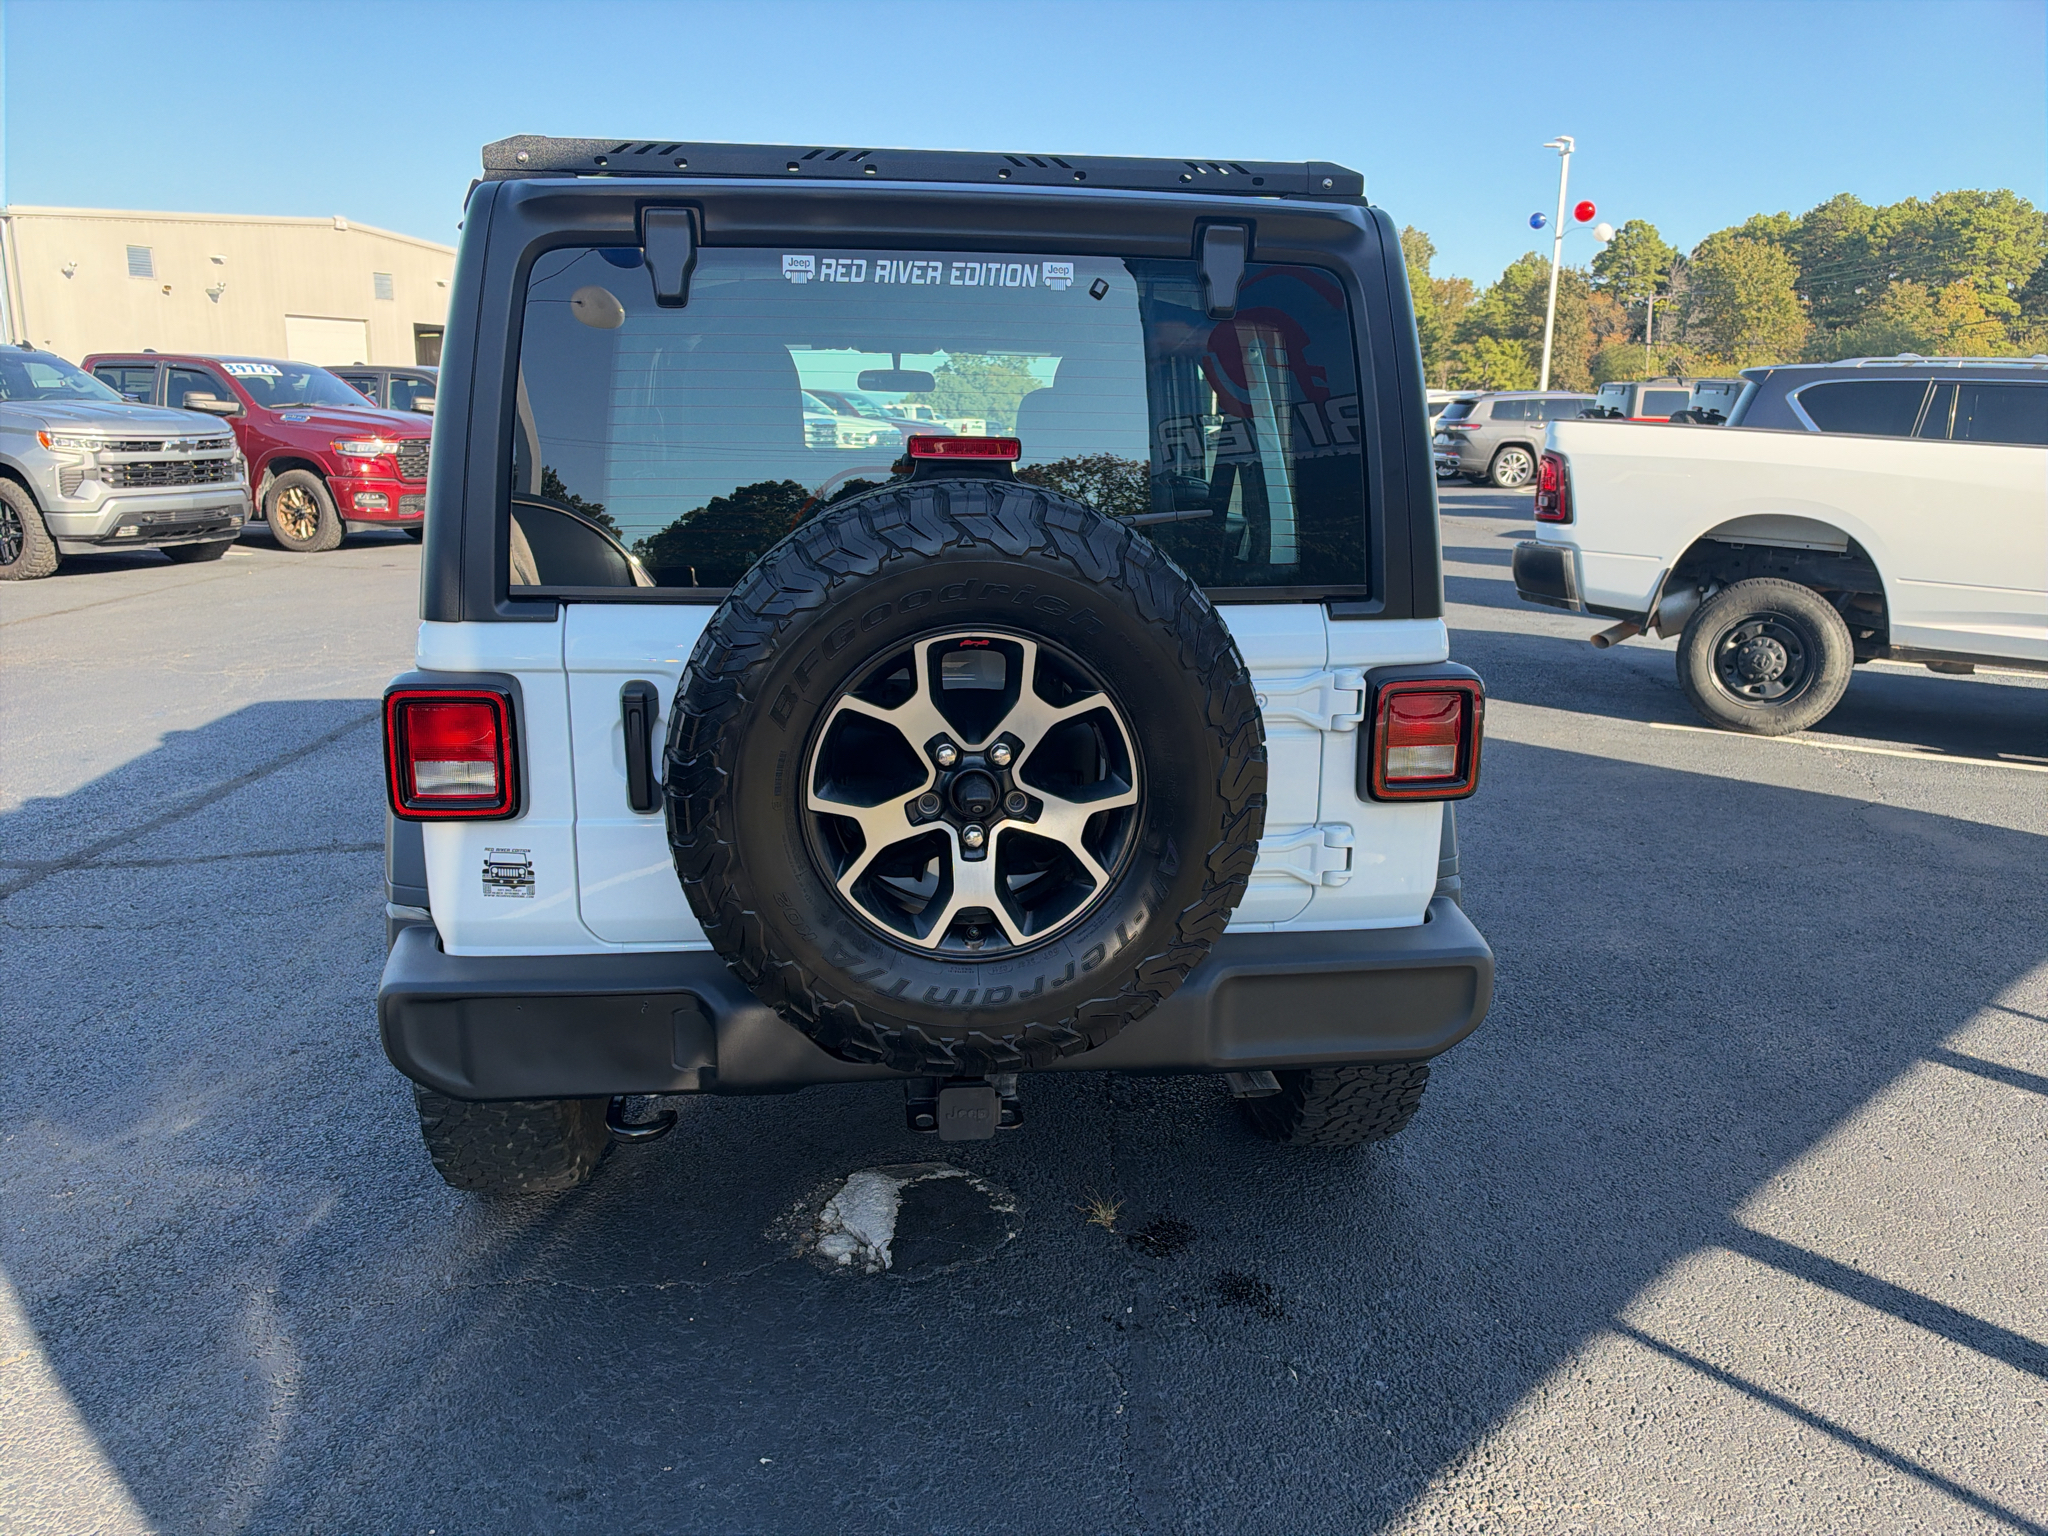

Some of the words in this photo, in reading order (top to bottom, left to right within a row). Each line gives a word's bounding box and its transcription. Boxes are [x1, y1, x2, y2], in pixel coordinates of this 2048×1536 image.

[788, 257, 811, 269] Jeep
[820, 258, 868, 283] RED
[874, 260, 943, 285] RIVER
[950, 262, 1039, 287] EDITION
[1048, 264, 1070, 276] Jeep
[224, 363, 278, 374] 39725
[768, 578, 1106, 731] BFGoodrich
[923, 833, 1182, 1006] All-Terrain
[820, 939, 912, 1000] T/A
[945, 1106, 990, 1121] Jeep
